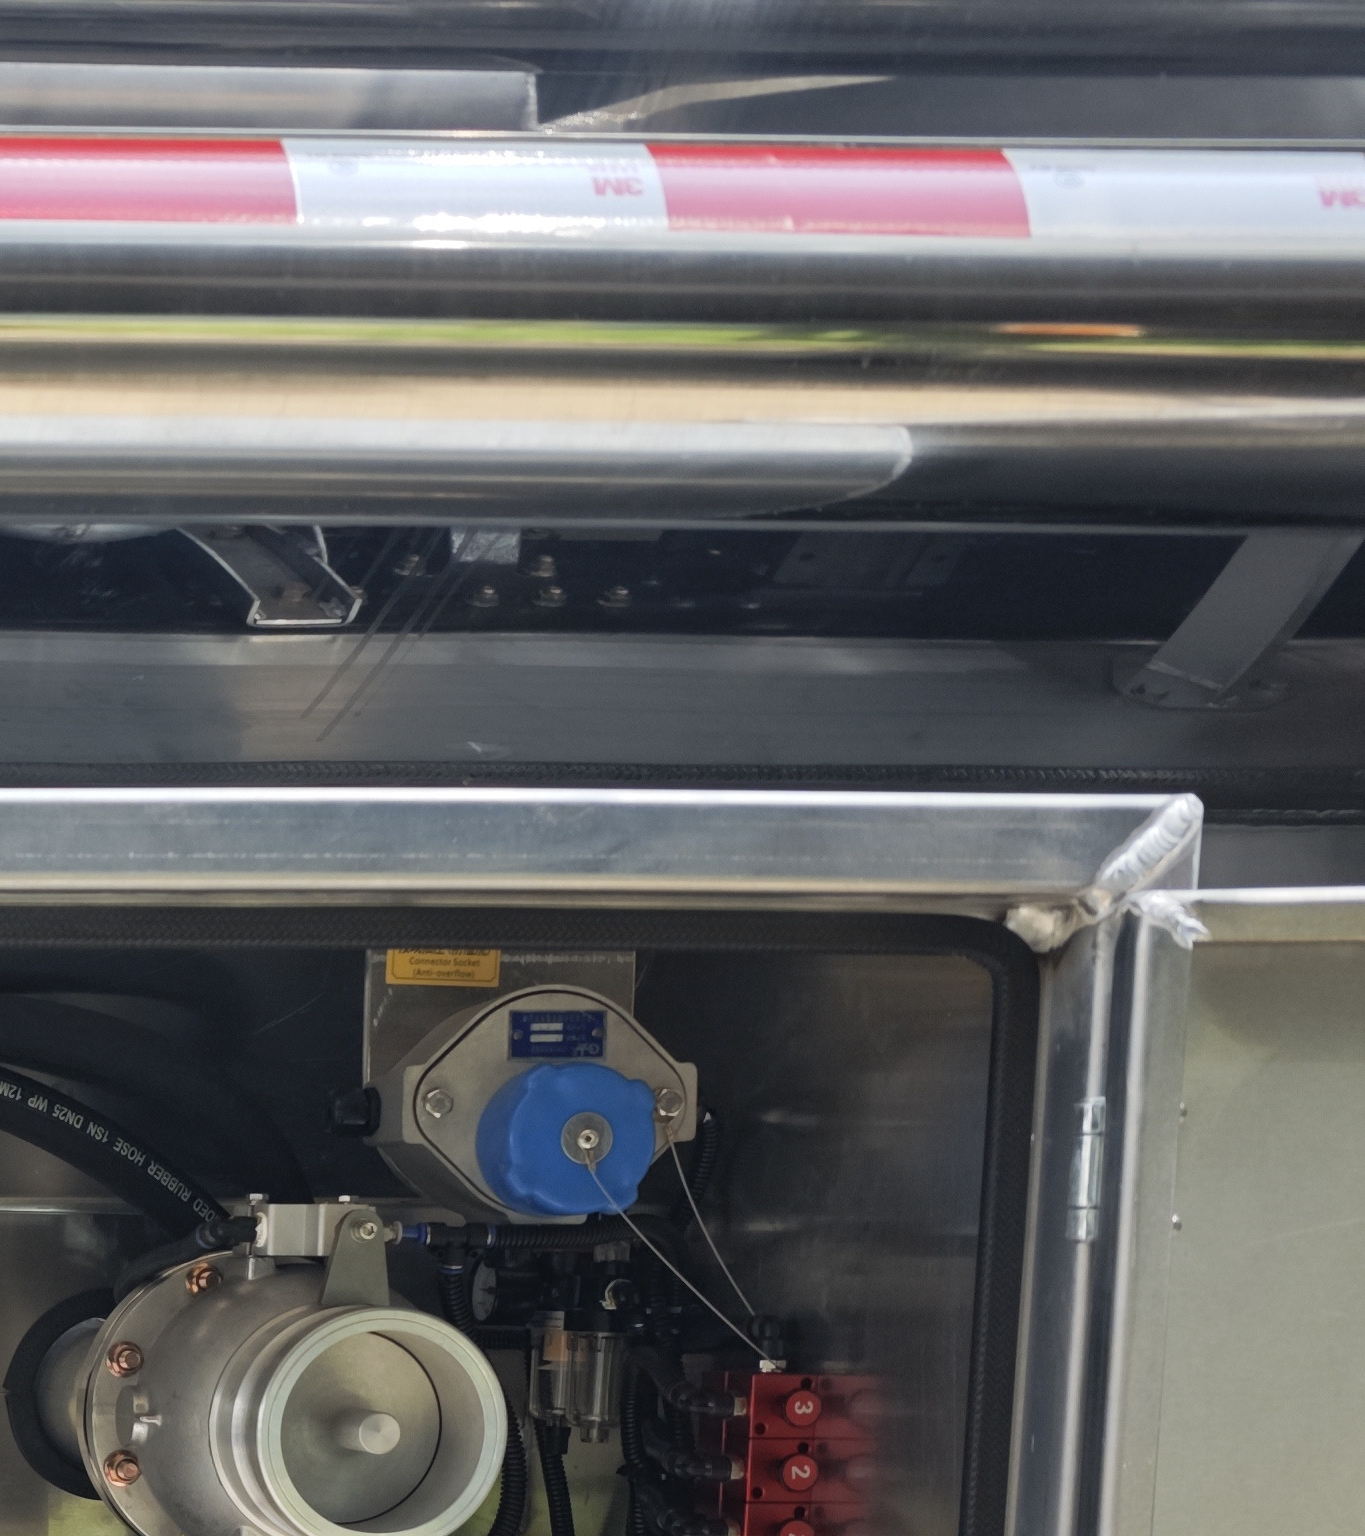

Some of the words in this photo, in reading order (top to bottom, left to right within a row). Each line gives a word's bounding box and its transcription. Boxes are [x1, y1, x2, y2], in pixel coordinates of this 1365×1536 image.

[409, 956, 451, 966] Connector
[453, 957, 480, 967] Socket
[28, 1096, 48, 1111] WP
[53, 1103, 84, 1129] DN25
[86, 1120, 111, 1143] 1SN
[113, 1134, 147, 1165] HOSE
[147, 1159, 194, 1204] RUBBER
[794, 1400, 813, 1416] 3
[791, 1465, 811, 1480] 2
